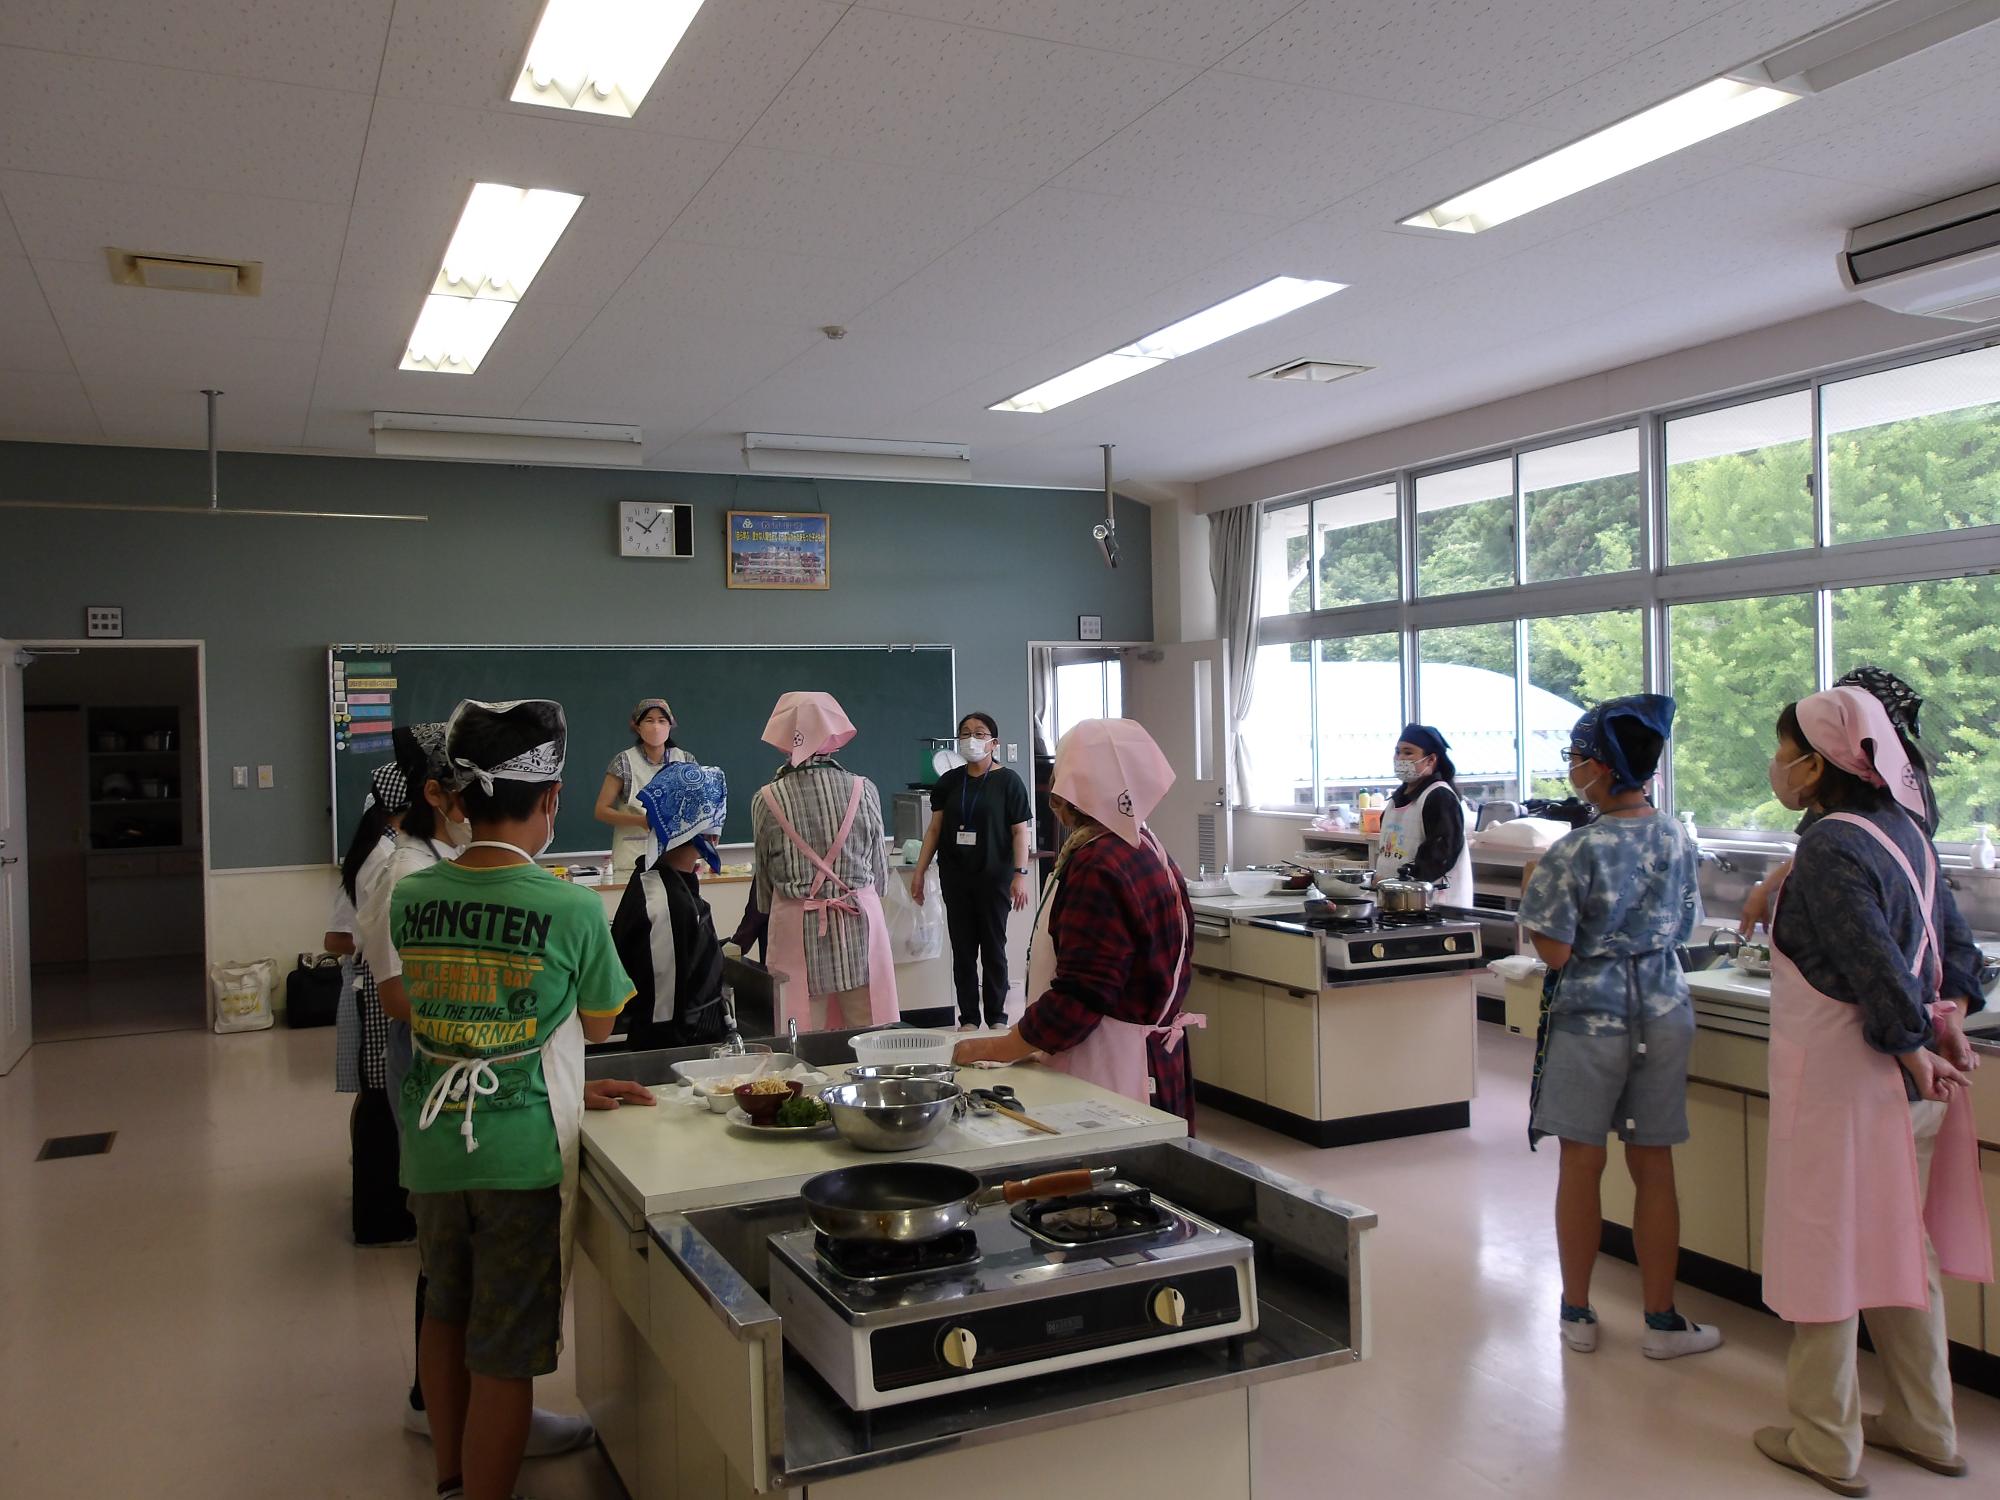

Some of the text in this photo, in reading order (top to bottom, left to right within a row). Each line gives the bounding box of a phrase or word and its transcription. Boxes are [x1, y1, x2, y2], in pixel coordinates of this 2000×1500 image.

[644, 507, 650, 515] 12
[402, 899, 553, 952] HANGTEN
[418, 1002, 440, 1017] ALL
[442, 1003, 466, 1019] THE
[468, 1005, 506, 1021] TIME
[414, 1019, 527, 1045] CALIFORNIA
